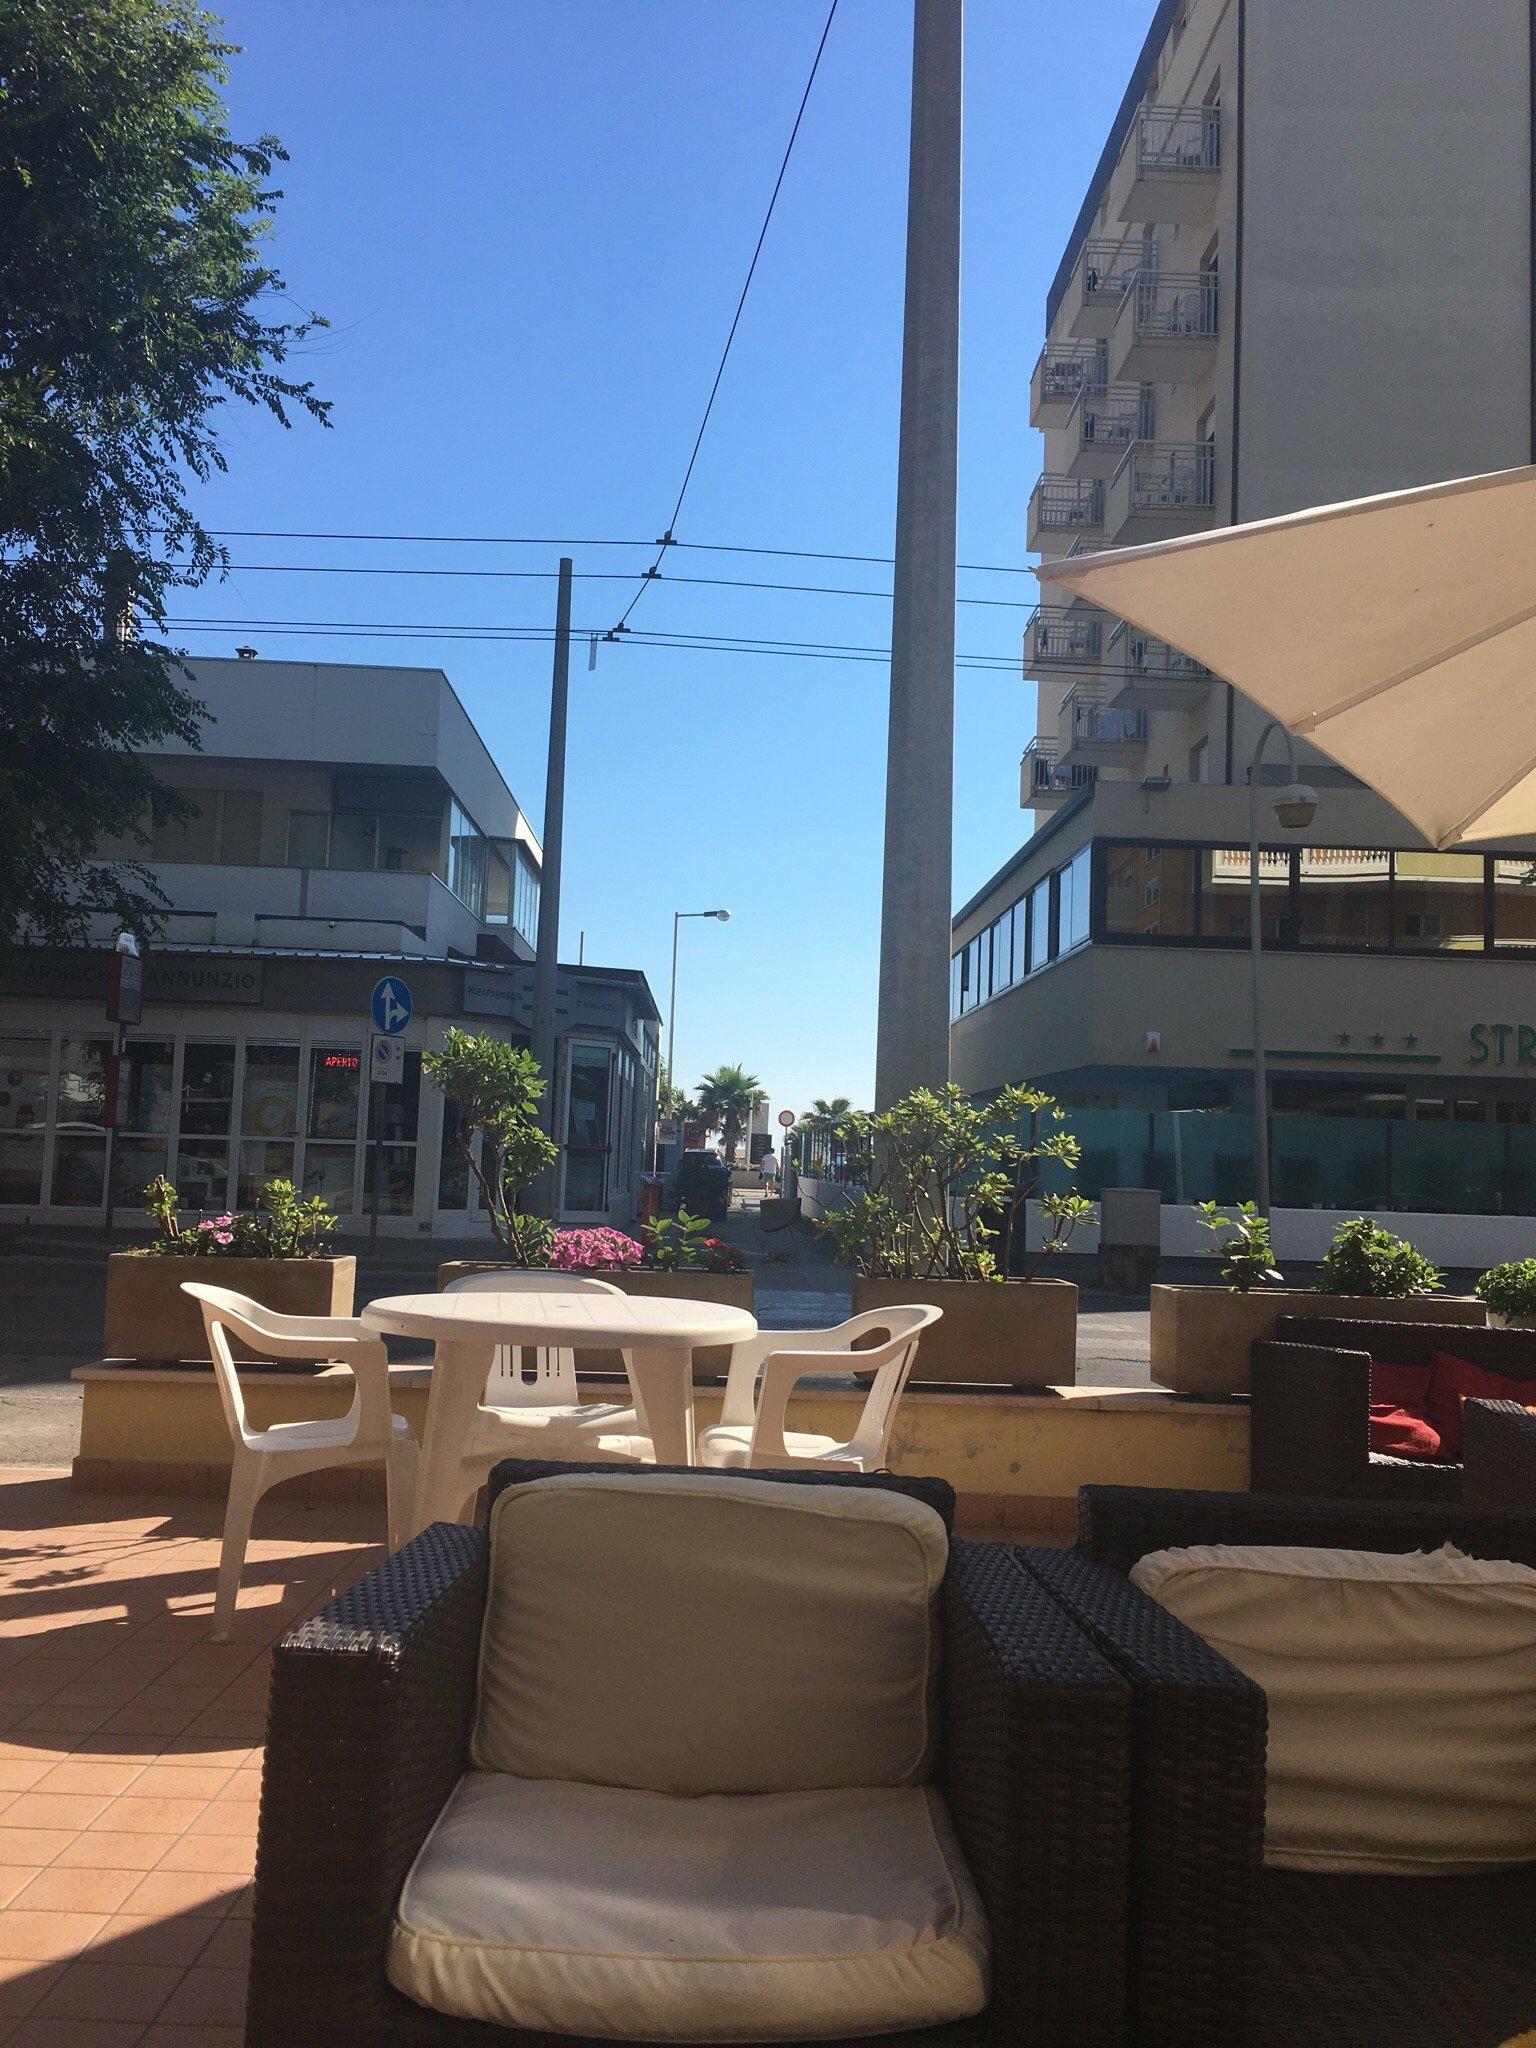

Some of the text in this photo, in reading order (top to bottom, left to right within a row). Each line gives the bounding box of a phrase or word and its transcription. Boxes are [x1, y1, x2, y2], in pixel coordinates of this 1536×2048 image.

[22, 964, 104, 982] ARMACI
[147, 969, 255, 989] ANNUNZIO
[325, 1056, 358, 1067] APERTO
